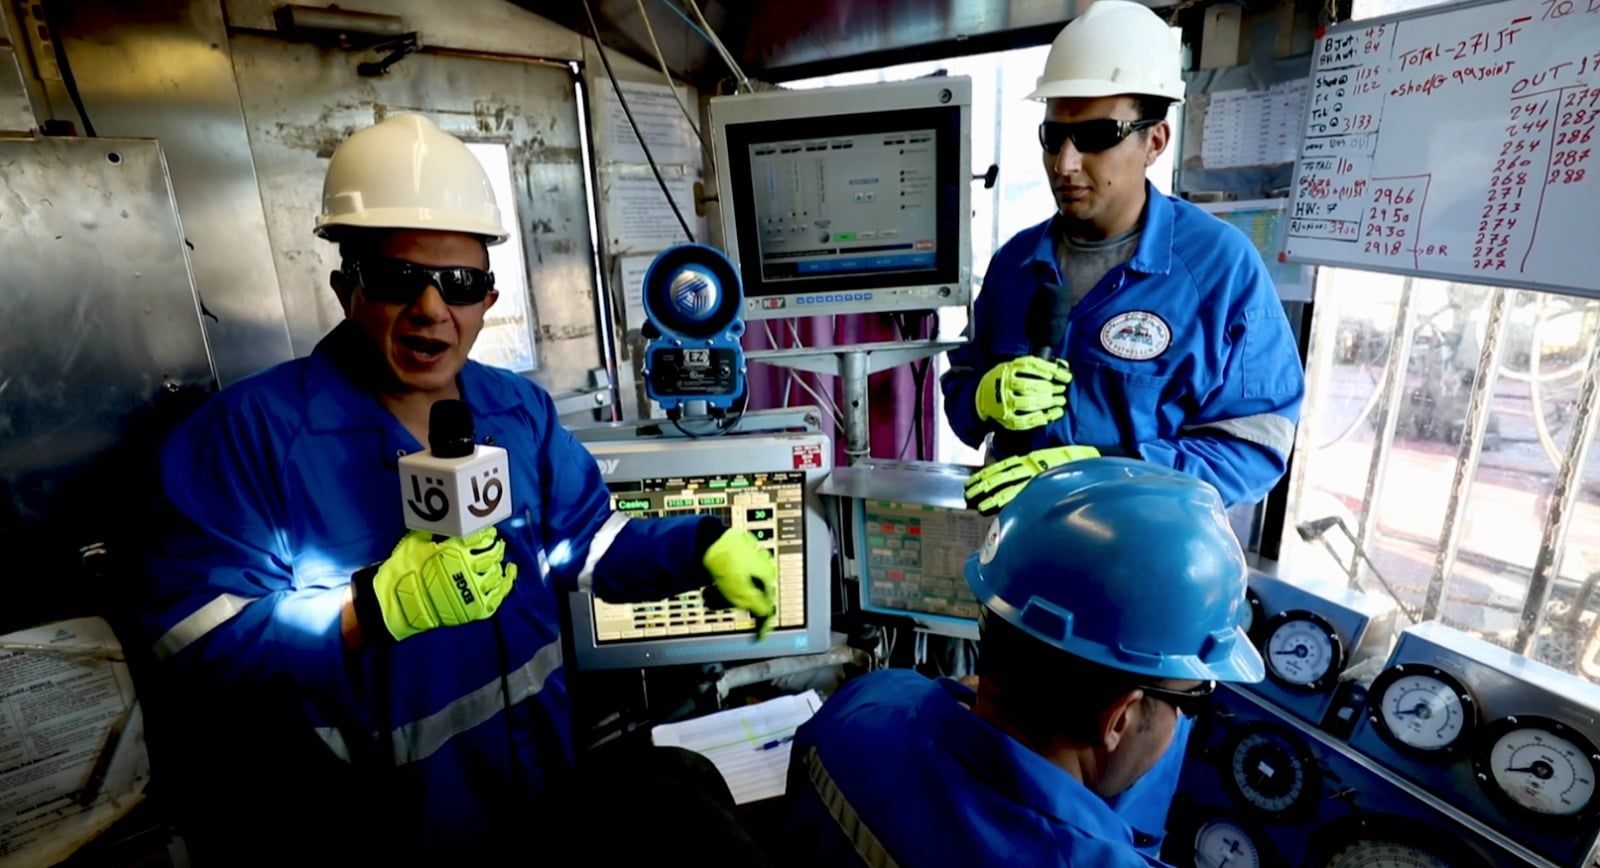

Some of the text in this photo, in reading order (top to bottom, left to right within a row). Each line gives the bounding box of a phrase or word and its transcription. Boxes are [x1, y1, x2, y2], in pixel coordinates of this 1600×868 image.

[1365, 23, 1385, 39] 45
[1511, 61, 1573, 94] OUT
[1564, 88, 1600, 108] 279
[1510, 100, 1548, 120] 241
[1343, 114, 1372, 132] 3133
[1505, 119, 1549, 137] 244
[1556, 125, 1595, 145] 286
[1500, 140, 1540, 157] 254
[1336, 157, 1354, 175] 110
[1492, 155, 1531, 173] 260
[1552, 148, 1591, 167] 287
[1490, 171, 1527, 187] 268
[1547, 169, 1586, 184] 288
[1373, 187, 1415, 204] 2966
[1487, 187, 1523, 201] 271
[1369, 207, 1409, 224] 2950
[1482, 202, 1521, 219] 273
[1365, 223, 1406, 237] 2930
[1478, 218, 1517, 232] 274
[1364, 241, 1402, 256] 2918
[1475, 233, 1511, 247] 275
[1472, 246, 1508, 258] 276
[1473, 259, 1506, 270] 277
[618, 500, 650, 510] Casing
[452, 571, 475, 605] EDGE
